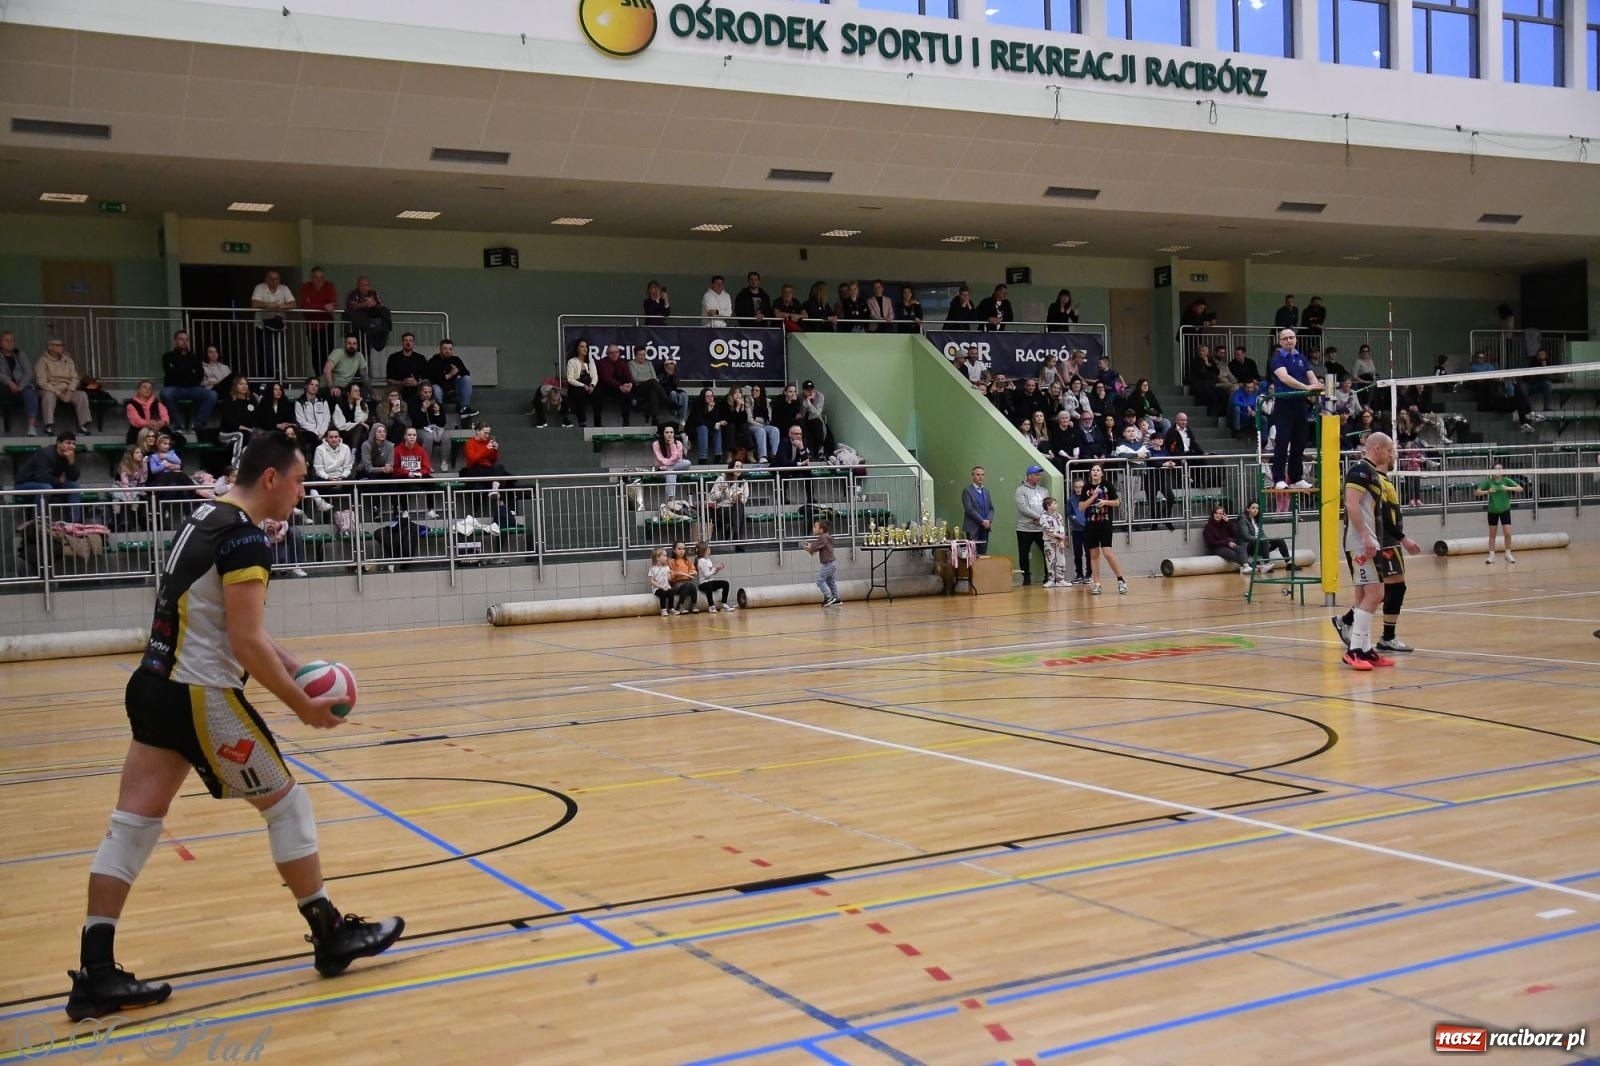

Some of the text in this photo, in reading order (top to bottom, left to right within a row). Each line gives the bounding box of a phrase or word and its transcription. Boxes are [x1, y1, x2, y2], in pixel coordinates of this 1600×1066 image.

[669, 0, 1268, 97] OŚRODEK SPORTU I REKREACJI RACIBÓRZ
[490, 254, 503, 266] E
[1013, 272, 1023, 283] F
[709, 339, 765, 360] OSiR
[731, 361, 765, 369] RACIBÓRZ
[240, 767, 261, 788] 11
